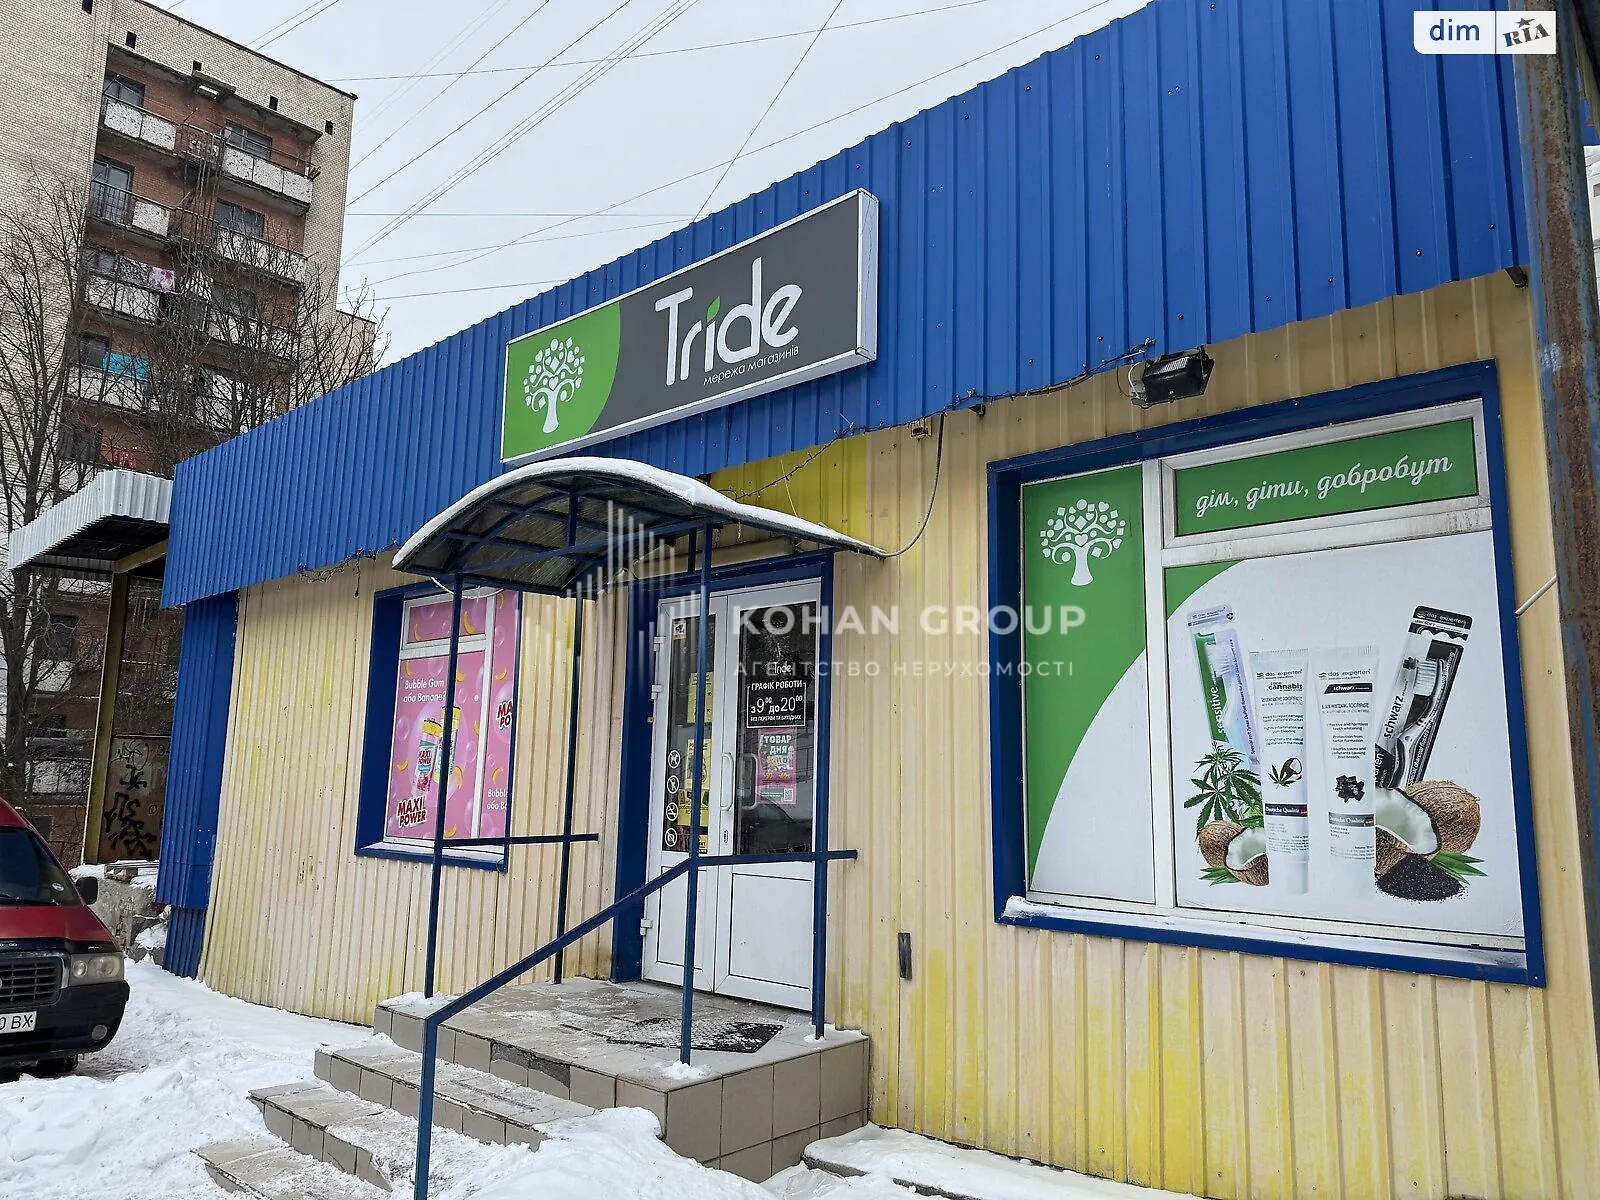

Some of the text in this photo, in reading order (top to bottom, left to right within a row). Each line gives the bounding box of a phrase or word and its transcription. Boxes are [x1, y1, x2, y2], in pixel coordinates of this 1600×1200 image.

[655, 257, 803, 386] Tride
[703, 345, 799, 386] мережа магазинів
[1196, 455, 1453, 518] дім, діти, добробут
[774, 660, 792, 674] Tride
[404, 678, 445, 690] Bubble Gum
[751, 679, 803, 691] ГРАФІК РОБОТИ
[1268, 682, 1303, 691] cannabis
[768, 705, 780, 715] до
[1383, 695, 1403, 739] schwarz
[763, 734, 792, 744] ТОВАР
[770, 745, 788, 755] ДНЯ
[397, 796, 424, 816] MAXI
[399, 810, 427, 827] POWER
